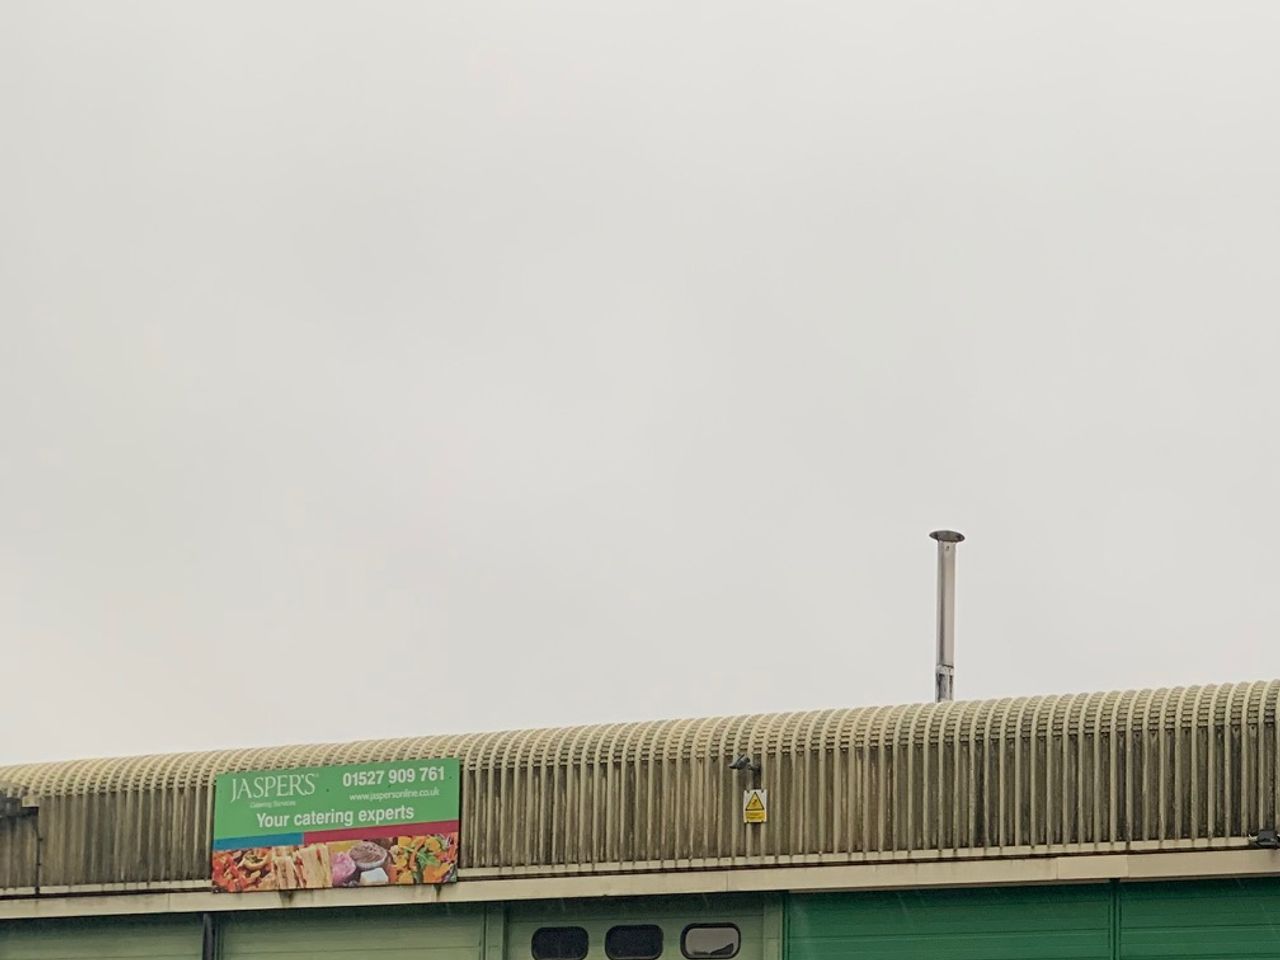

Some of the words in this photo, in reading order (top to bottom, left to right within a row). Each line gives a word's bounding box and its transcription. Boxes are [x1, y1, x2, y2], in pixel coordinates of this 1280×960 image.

[342, 769, 385, 787] 01527
[388, 768, 415, 784] 909
[419, 766, 445, 782] 761
[230, 773, 316, 803] JASPER'S
[349, 786, 440, 802] www.jaspersonline.co.uk
[256, 813, 290, 828] Your
[294, 808, 353, 828] catering
[358, 804, 415, 823] experts
